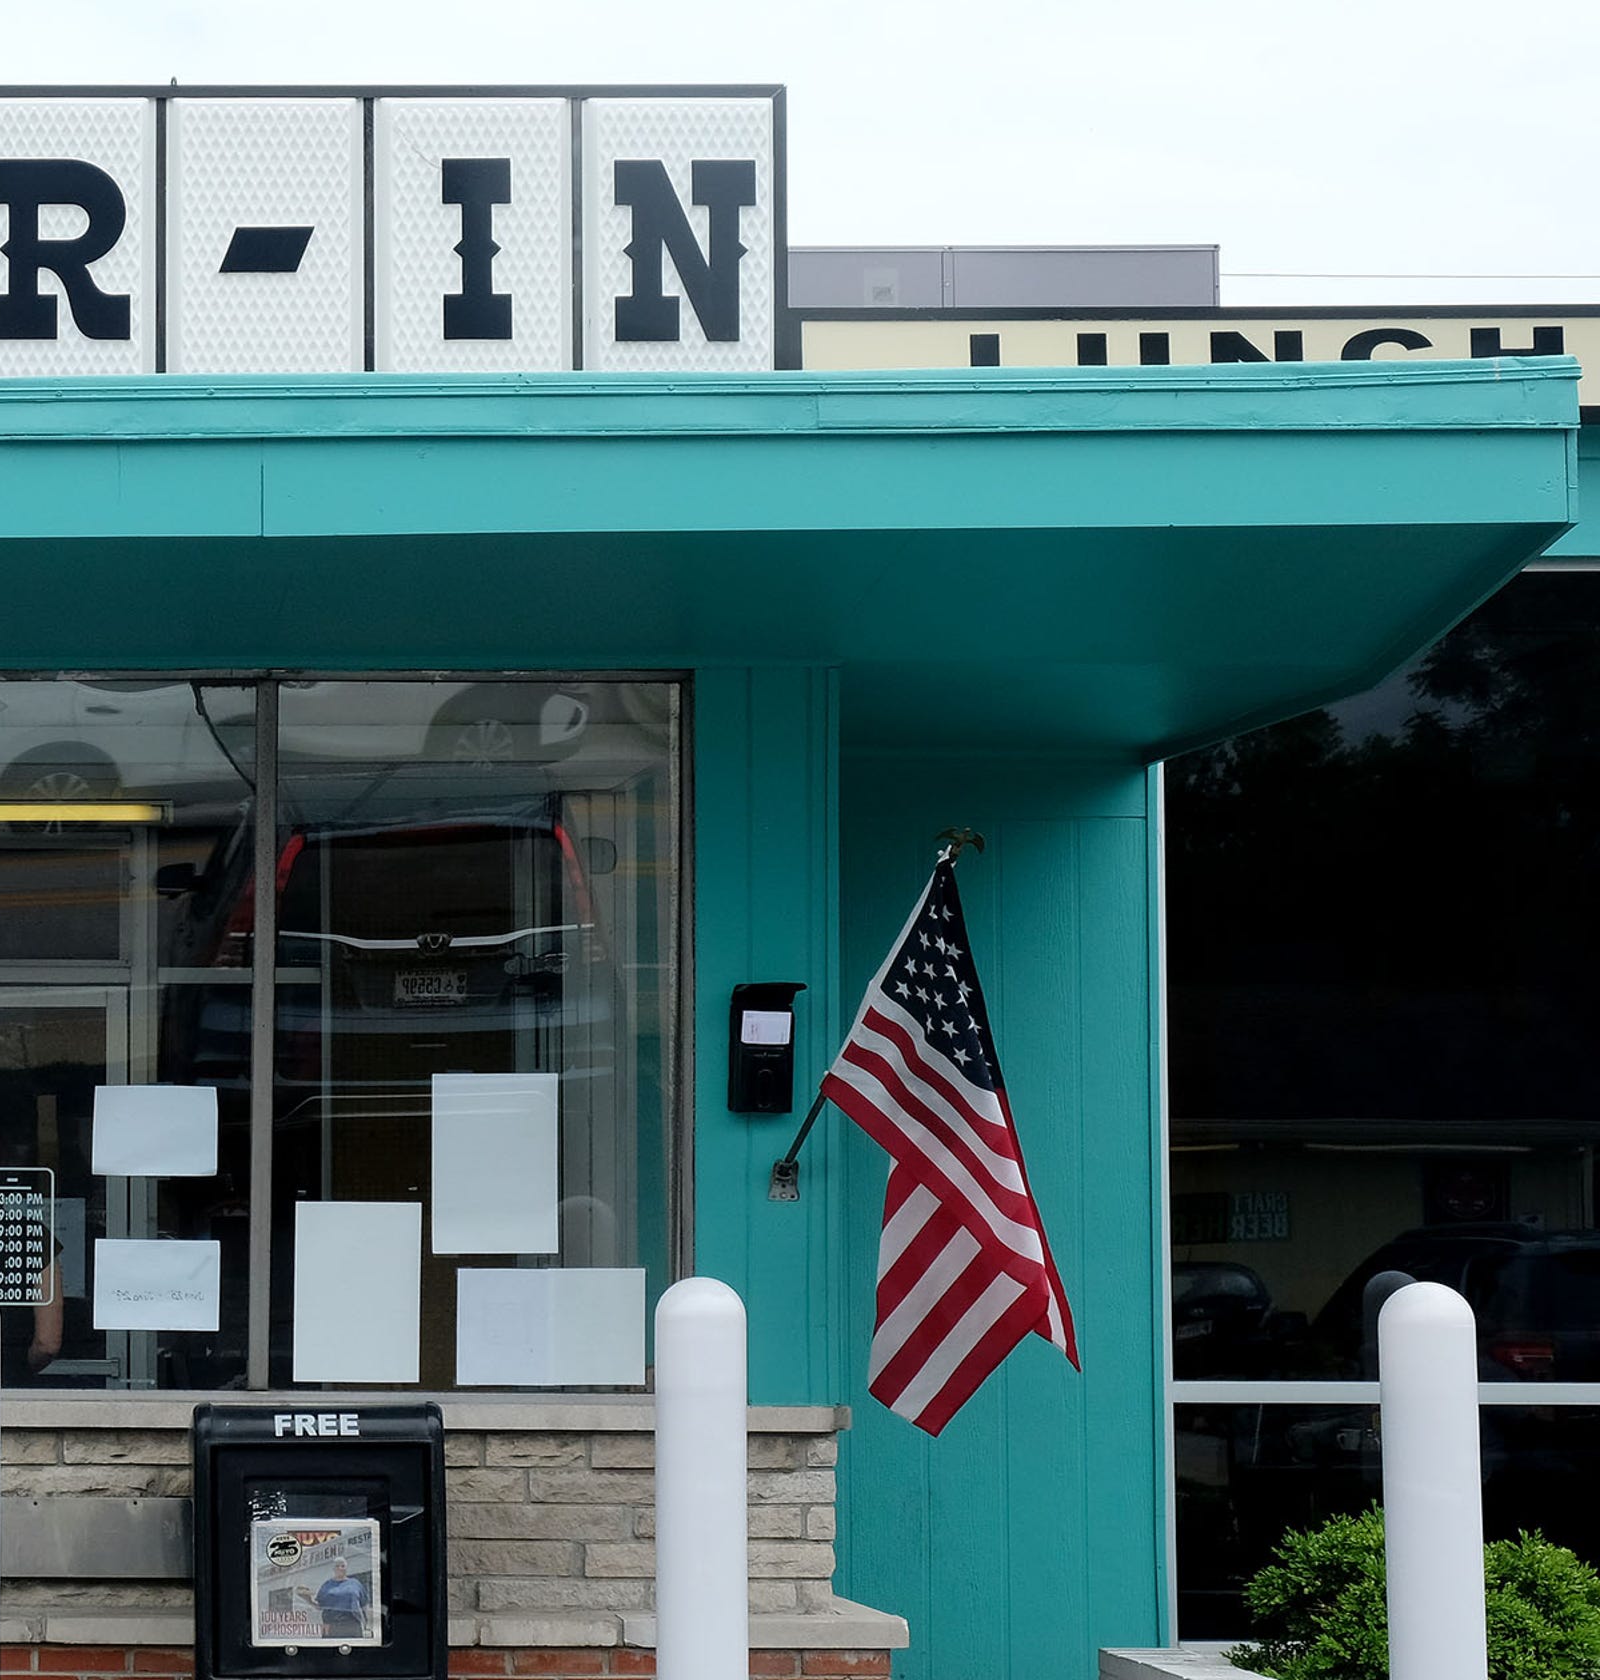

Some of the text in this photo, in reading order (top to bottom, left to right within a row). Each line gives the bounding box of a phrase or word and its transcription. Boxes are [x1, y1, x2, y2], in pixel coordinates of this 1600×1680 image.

[26, 1193, 43, 1205] PM
[26, 1209, 43, 1221] PM
[26, 1225, 43, 1237] PM
[26, 1241, 43, 1252] PM
[26, 1257, 43, 1268] PM
[26, 1273, 43, 1284] PM
[26, 1289, 43, 1300] PM
[274, 1414, 360, 1437] FREE
[261, 1610, 308, 1623] 100 YEARS
